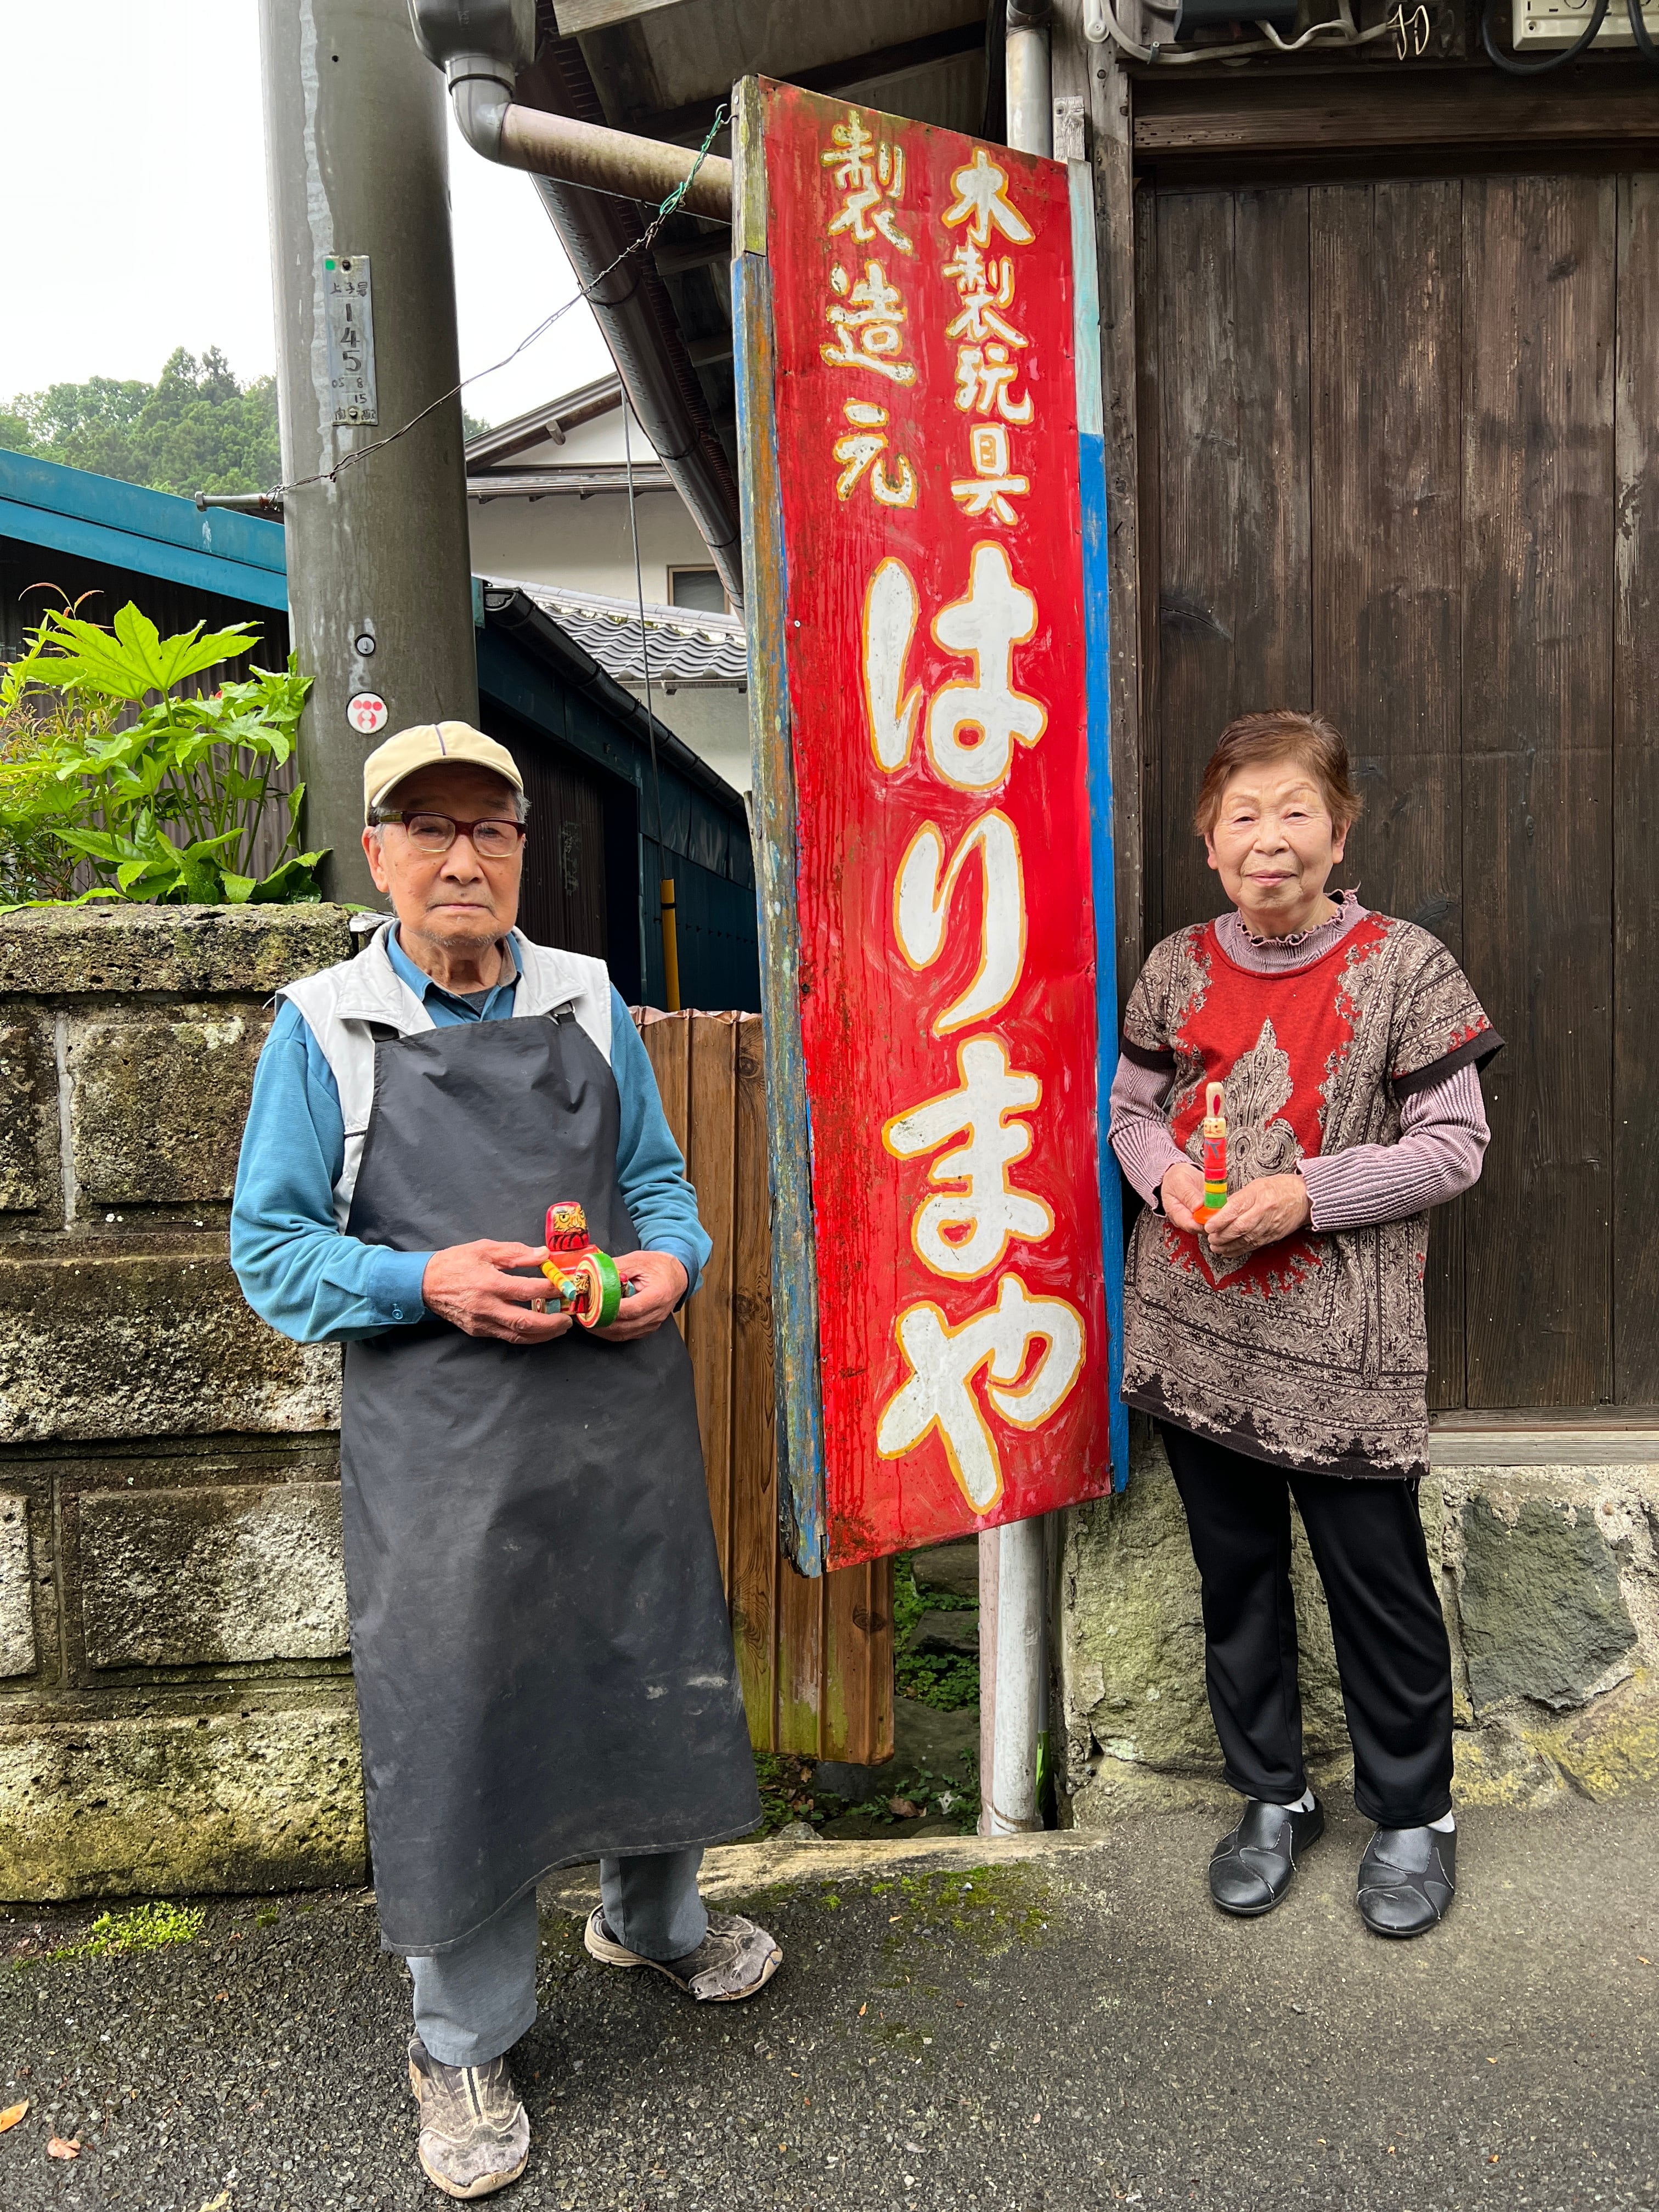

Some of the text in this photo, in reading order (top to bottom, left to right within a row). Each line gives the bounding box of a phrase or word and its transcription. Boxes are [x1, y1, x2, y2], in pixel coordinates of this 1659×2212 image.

[340, 303, 362, 372] 145
[354, 393, 367, 404] 15
[357, 377, 363, 388] 8
[820, 111, 918, 508] 製造元
[942, 146, 1035, 525] 木製玩具
[862, 541, 1086, 1515] はりまや
